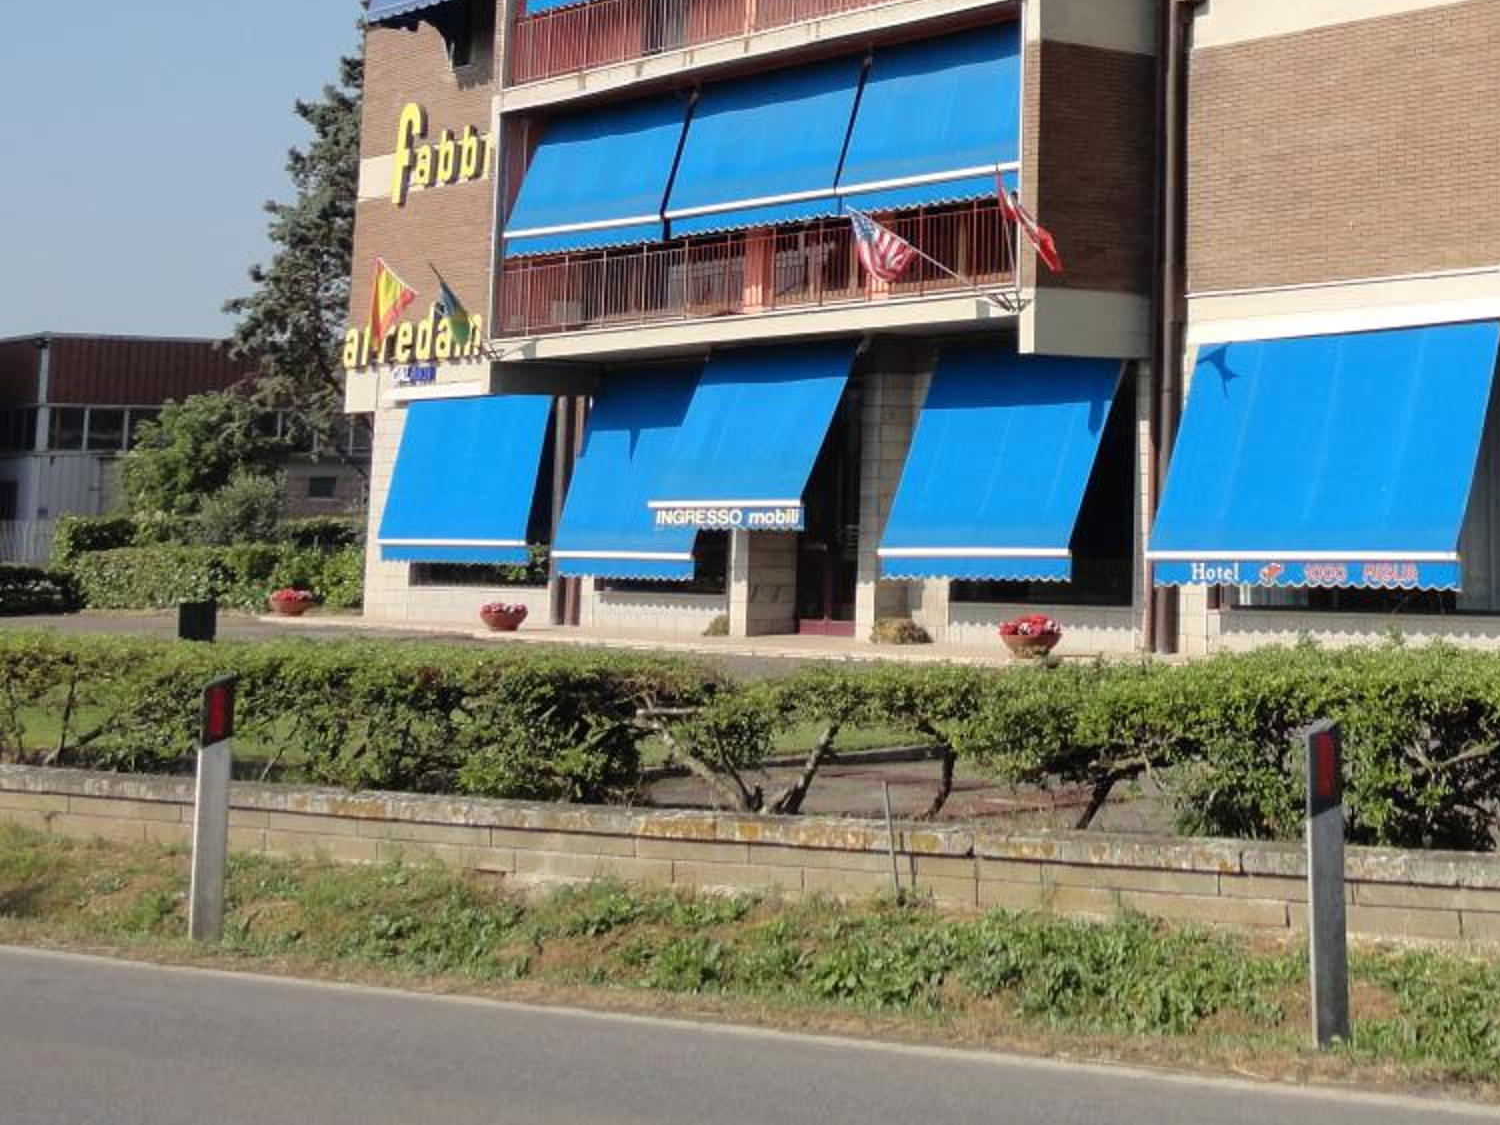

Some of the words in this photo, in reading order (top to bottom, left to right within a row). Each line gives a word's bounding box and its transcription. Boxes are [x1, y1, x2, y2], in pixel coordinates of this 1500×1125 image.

[656, 508, 742, 525] INGRESSO
[748, 507, 800, 525] mobili
[1189, 561, 1239, 581] Hotel
